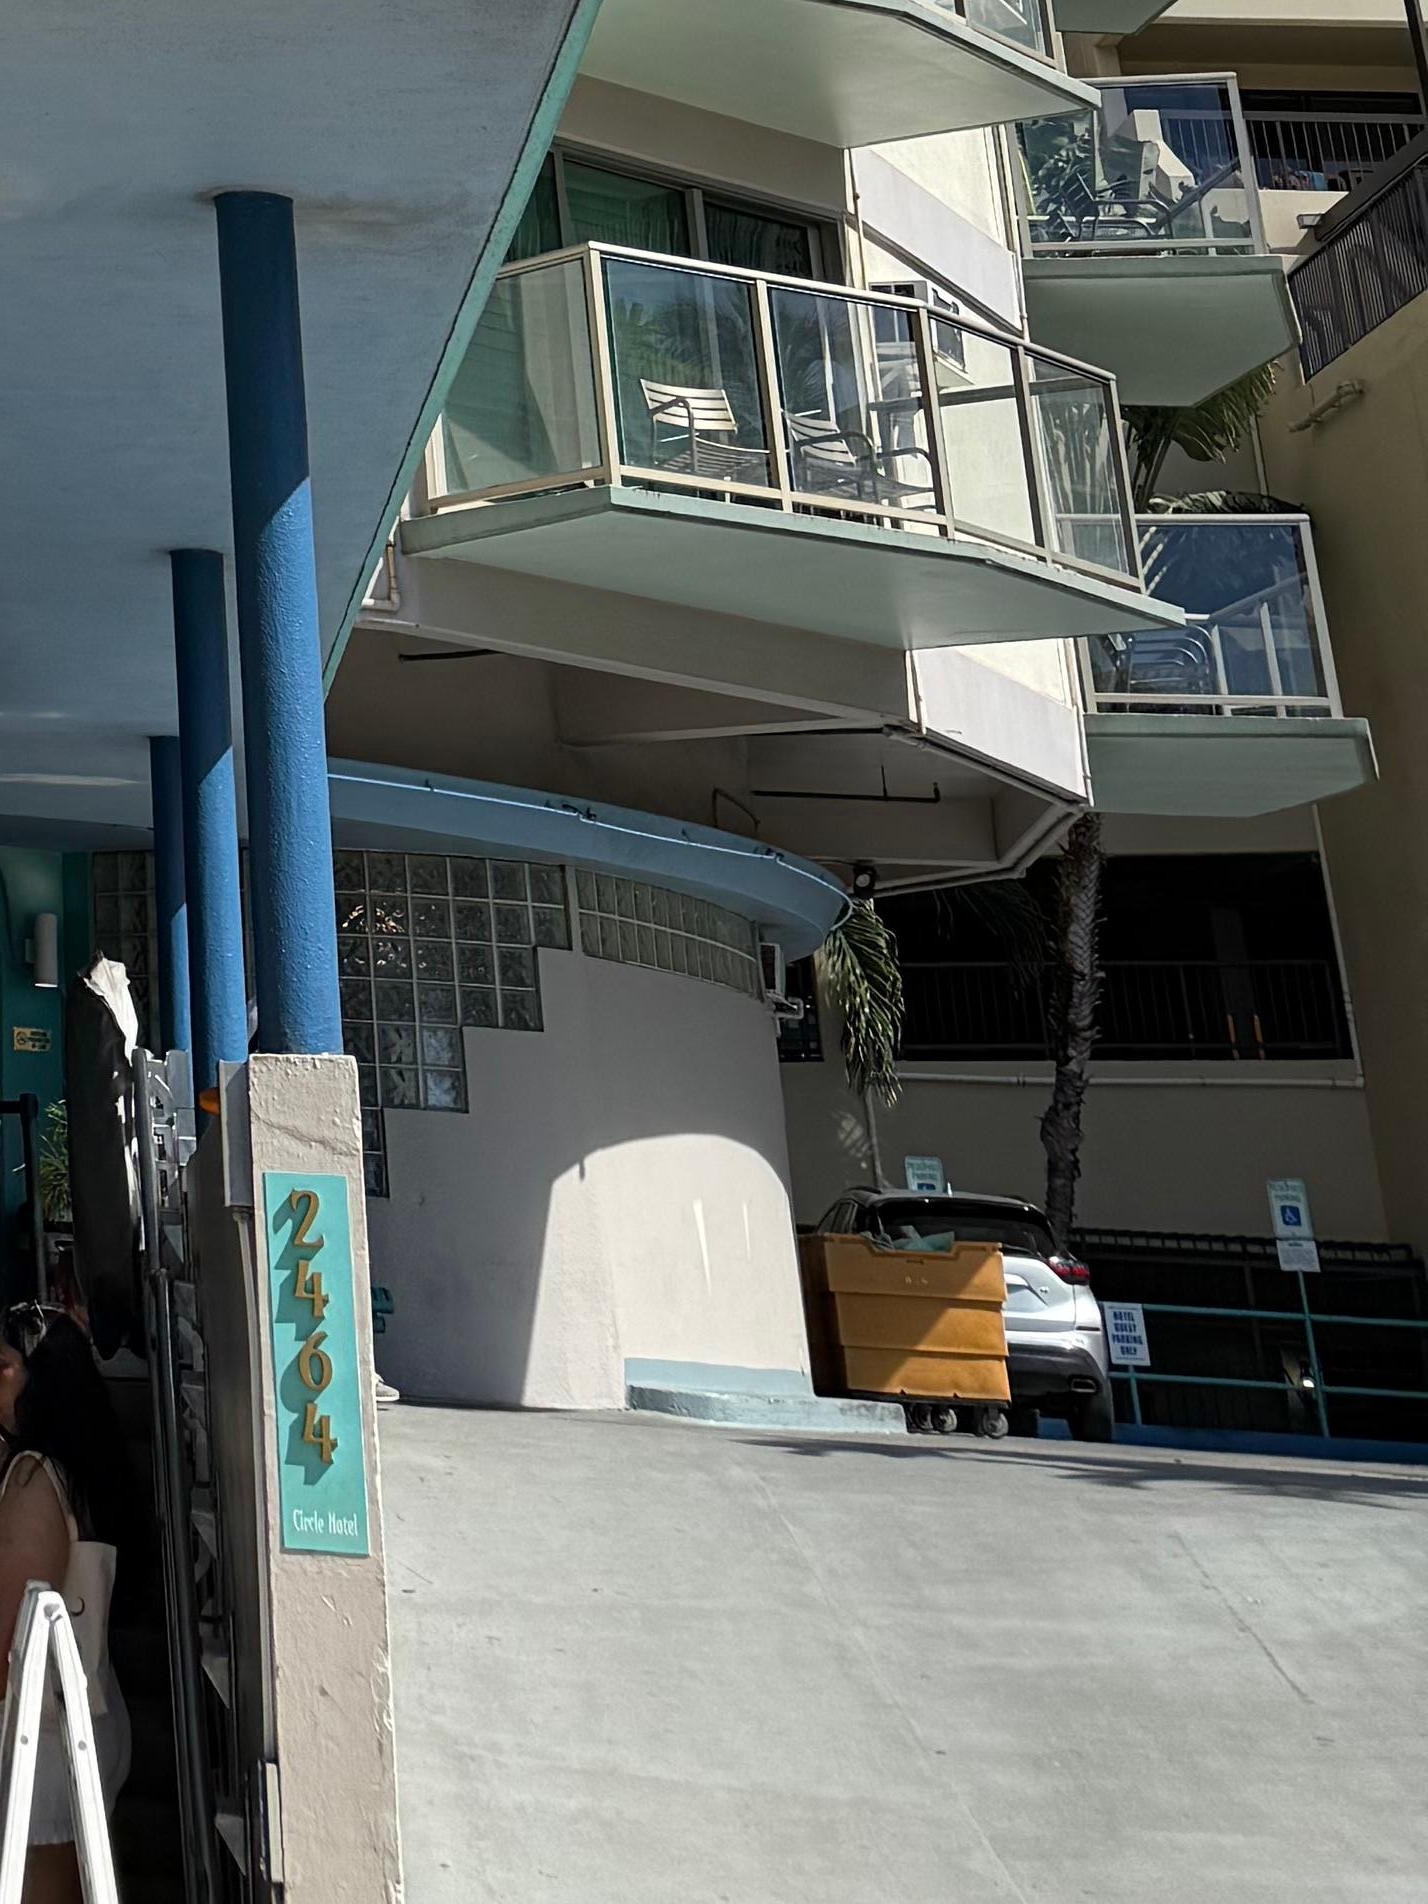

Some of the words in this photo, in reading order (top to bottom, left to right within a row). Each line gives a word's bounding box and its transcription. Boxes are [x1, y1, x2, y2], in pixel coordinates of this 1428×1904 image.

[290, 1188, 339, 1465] 2464
[293, 1509, 324, 1533] Circle
[328, 1511, 358, 1536] Hotel
